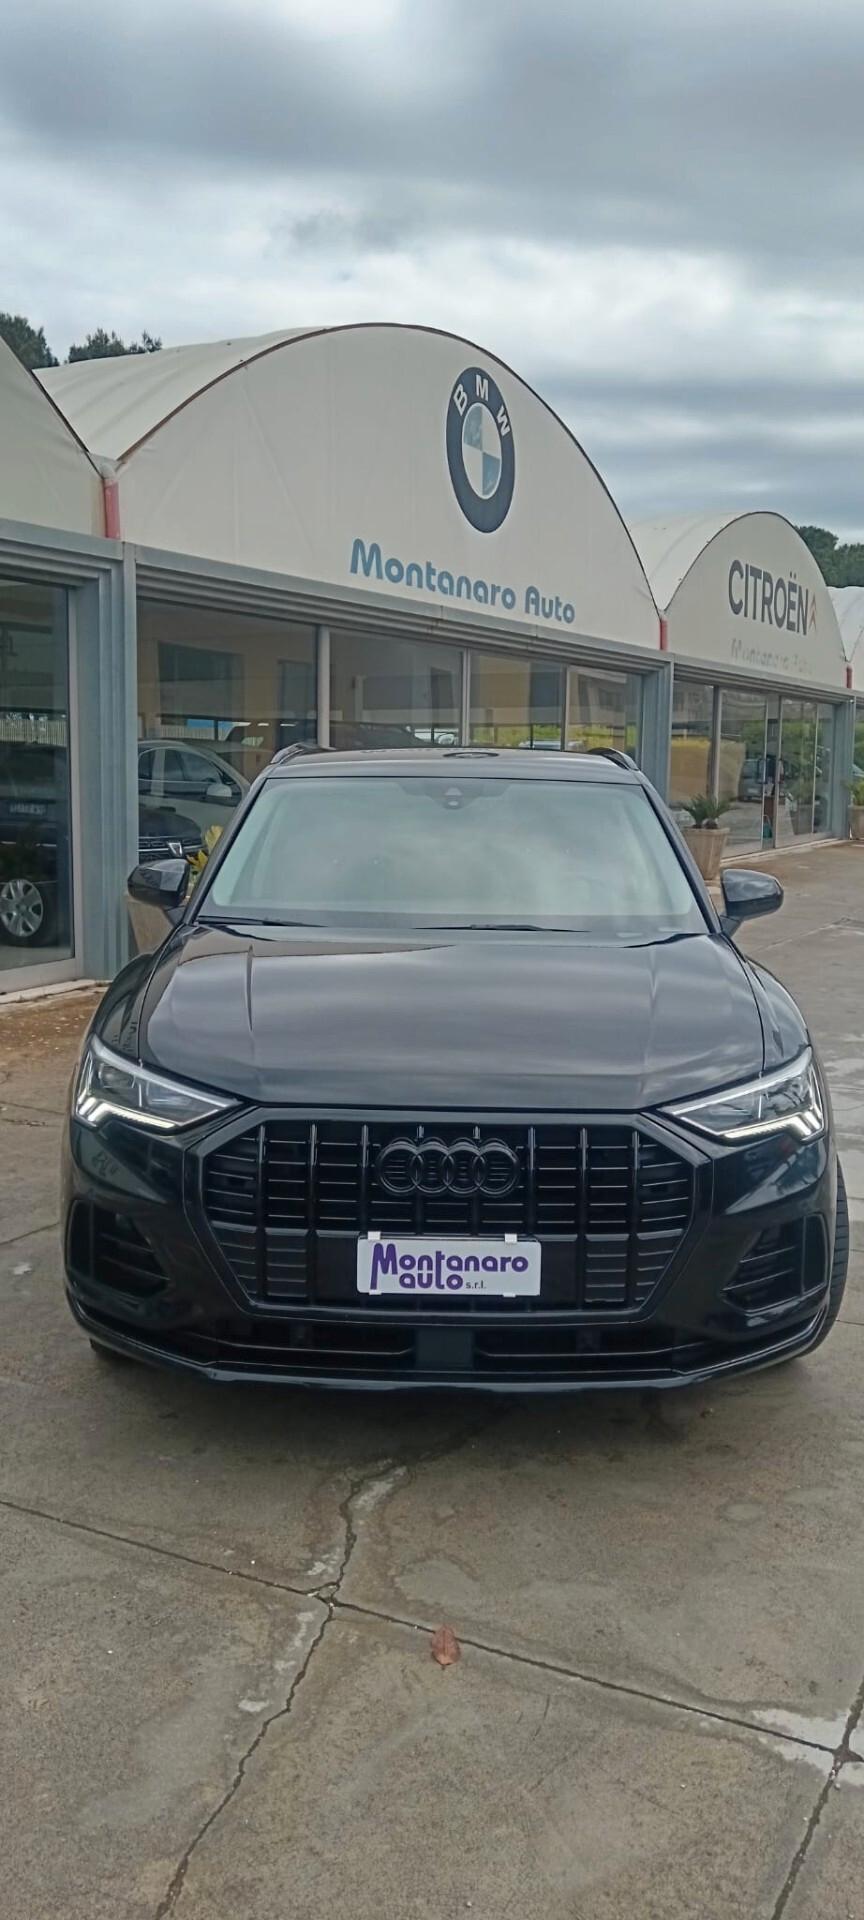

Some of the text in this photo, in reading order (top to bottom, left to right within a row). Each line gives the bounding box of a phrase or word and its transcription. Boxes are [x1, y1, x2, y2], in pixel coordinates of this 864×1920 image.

[453, 374, 511, 437] BMW
[350, 538, 575, 624] Montanaro Auto
[728, 559, 809, 636] CITROËN
[370, 1243, 529, 1290] Montanaro
[465, 1280, 487, 1289] s.r.l.
